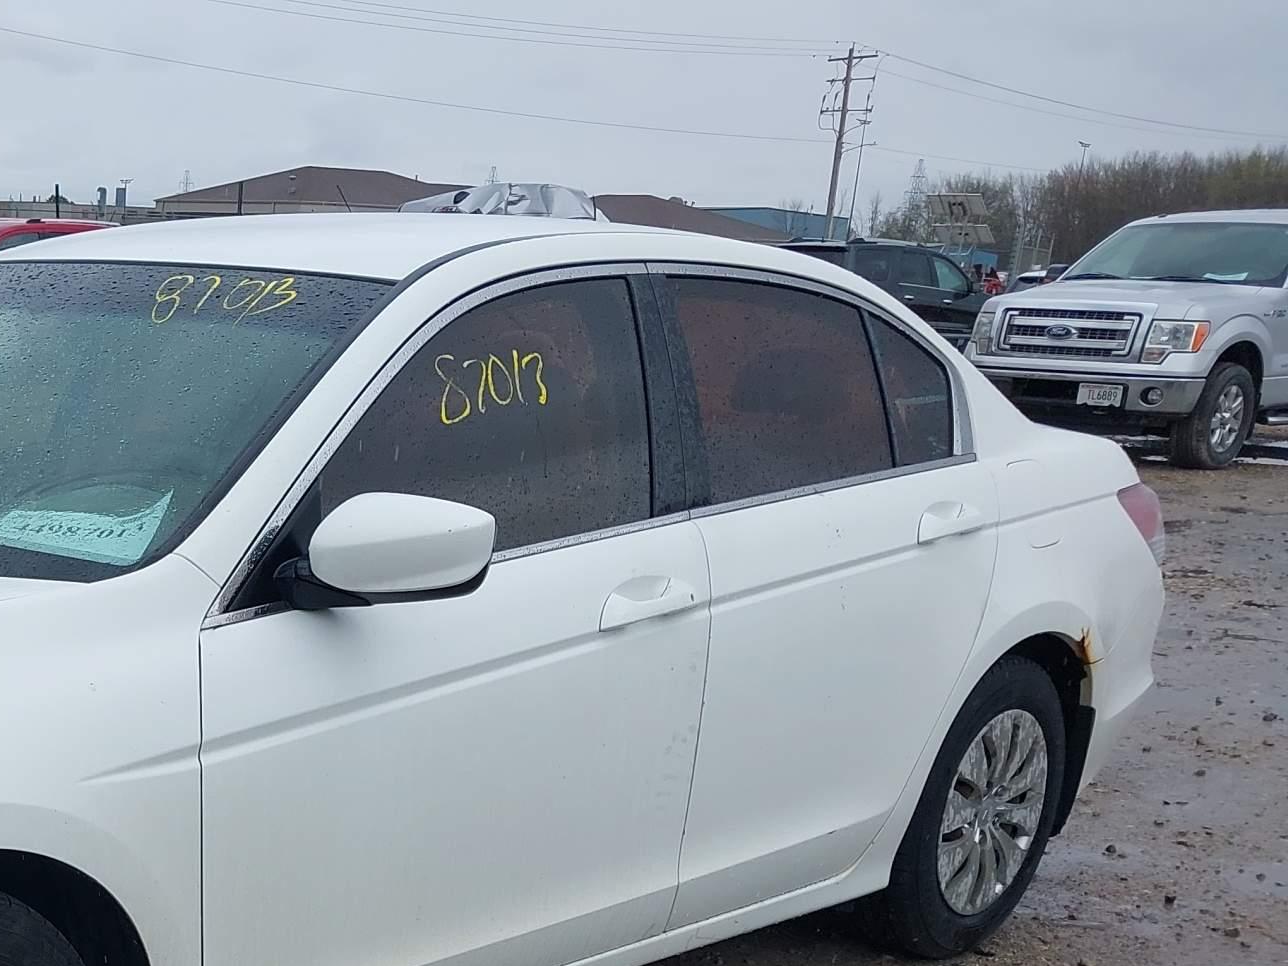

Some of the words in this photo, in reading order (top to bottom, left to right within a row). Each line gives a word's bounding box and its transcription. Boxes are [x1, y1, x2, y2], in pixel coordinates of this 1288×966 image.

[151, 274, 297, 328] 87013
[434, 349, 548, 424] 87013
[1087, 389, 1118, 401] TL6889
